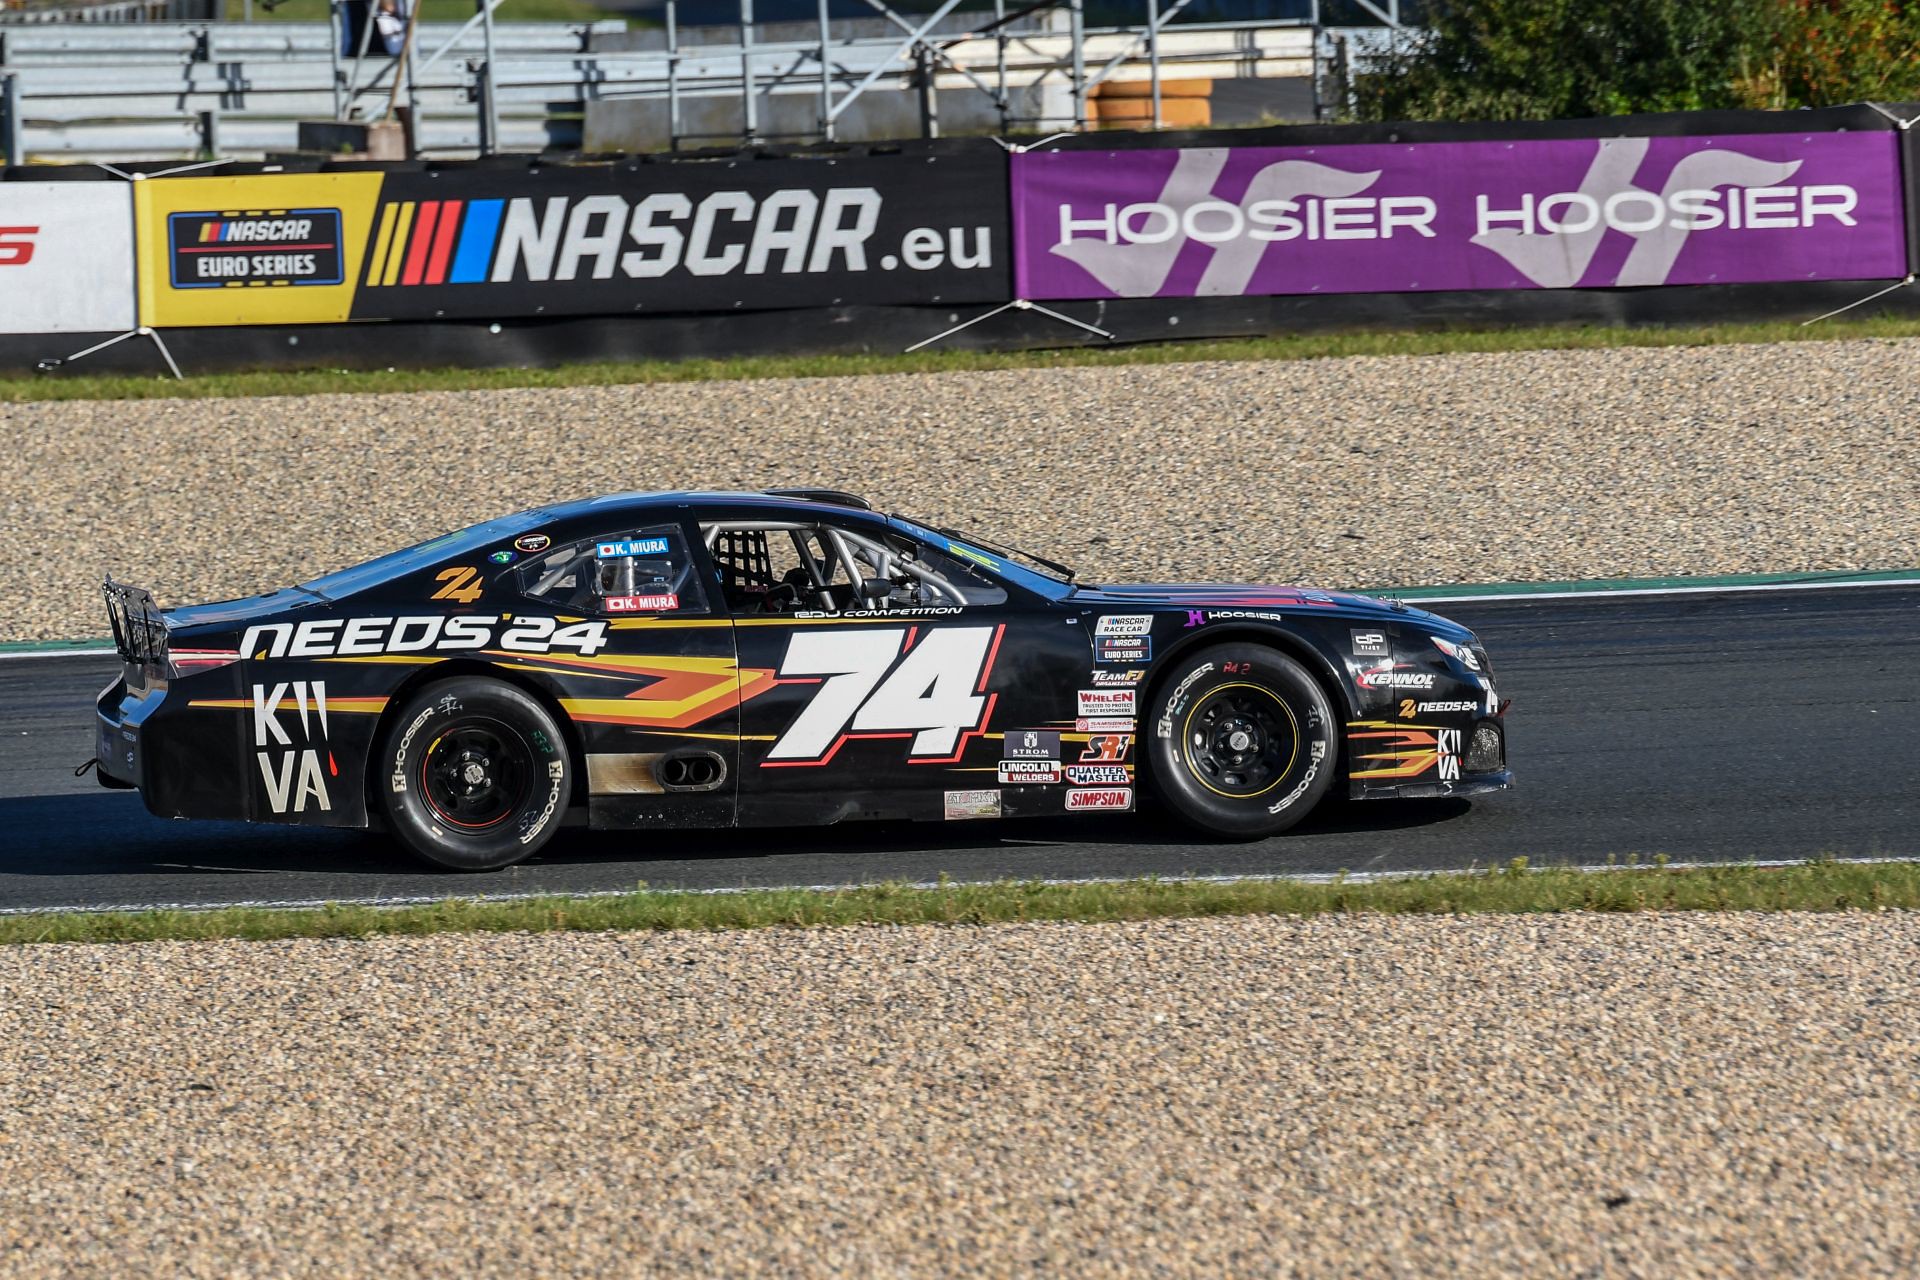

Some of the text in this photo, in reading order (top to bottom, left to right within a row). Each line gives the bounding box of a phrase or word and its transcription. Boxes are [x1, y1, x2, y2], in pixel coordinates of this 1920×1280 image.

[1477, 184, 1858, 235] HOOSIER
[1060, 194, 1437, 246] HOOSIER
[226, 219, 312, 242] NASCAR
[197, 254, 316, 277] EURO SERIES
[615, 540, 667, 555] K. MIURA
[430, 567, 483, 603] 24
[625, 596, 675, 609] K. MIURA
[843, 607, 964, 617] COMPETITION
[1208, 611, 1281, 621] HOOSIER
[1115, 617, 1145, 625] NASCAR
[1114, 639, 1141, 647] NASCAR
[1362, 673, 1434, 685] KENNOL
[767, 627, 994, 758] 74
[1080, 692, 1133, 702] WHELEN
[1162, 662, 1215, 721] HOOSIER
[1399, 699, 1417, 718] 24
[394, 707, 436, 774] HOOSIER
[1080, 734, 1130, 761] SRI
[1002, 763, 1050, 772] LINCOLN
[1068, 767, 1123, 778] QUARTER
[1078, 774, 1126, 782] MASTER
[1267, 756, 1320, 814] HOOSIER
[1071, 792, 1126, 806] SIMPSON
[520, 778, 560, 844] HOOSIER
